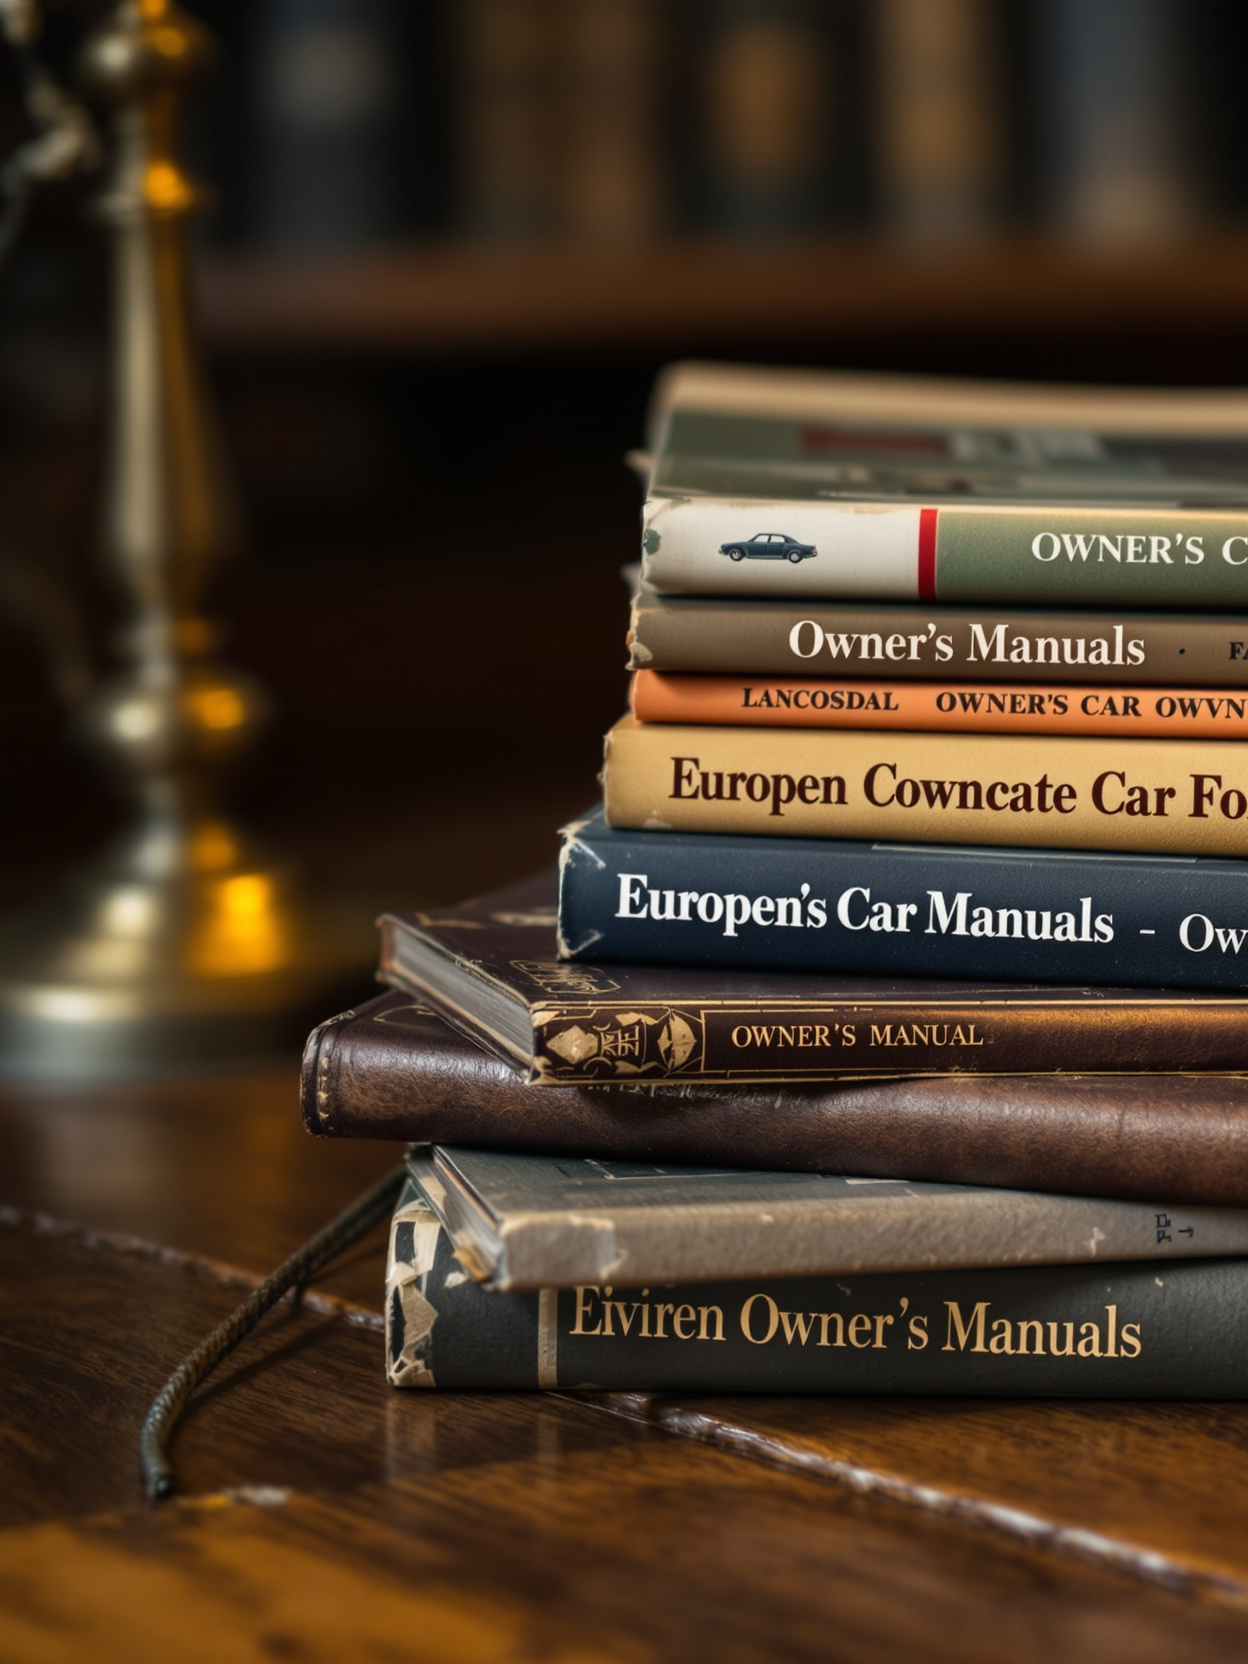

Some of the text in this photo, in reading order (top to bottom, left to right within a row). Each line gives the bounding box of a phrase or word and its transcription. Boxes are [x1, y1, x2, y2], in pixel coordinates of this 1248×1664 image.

[1031, 532, 1205, 565] OWNER'S
[788, 619, 954, 662] Owner's
[966, 623, 1146, 665] Manuals
[742, 687, 899, 711] LANCOSDAL
[936, 692, 1069, 717] OWNER'S
[1080, 695, 1142, 717] CAR
[669, 757, 847, 815] Europen
[863, 762, 1078, 814] Cowncate
[1091, 770, 1177, 817] Car
[614, 873, 828, 937] Europen's
[837, 886, 918, 933] Car
[924, 890, 1114, 943] Manuals
[731, 1023, 985, 1048] OWNER'S MANUAL
[569, 1286, 1142, 1358] Eiviren Owner's Manuals
